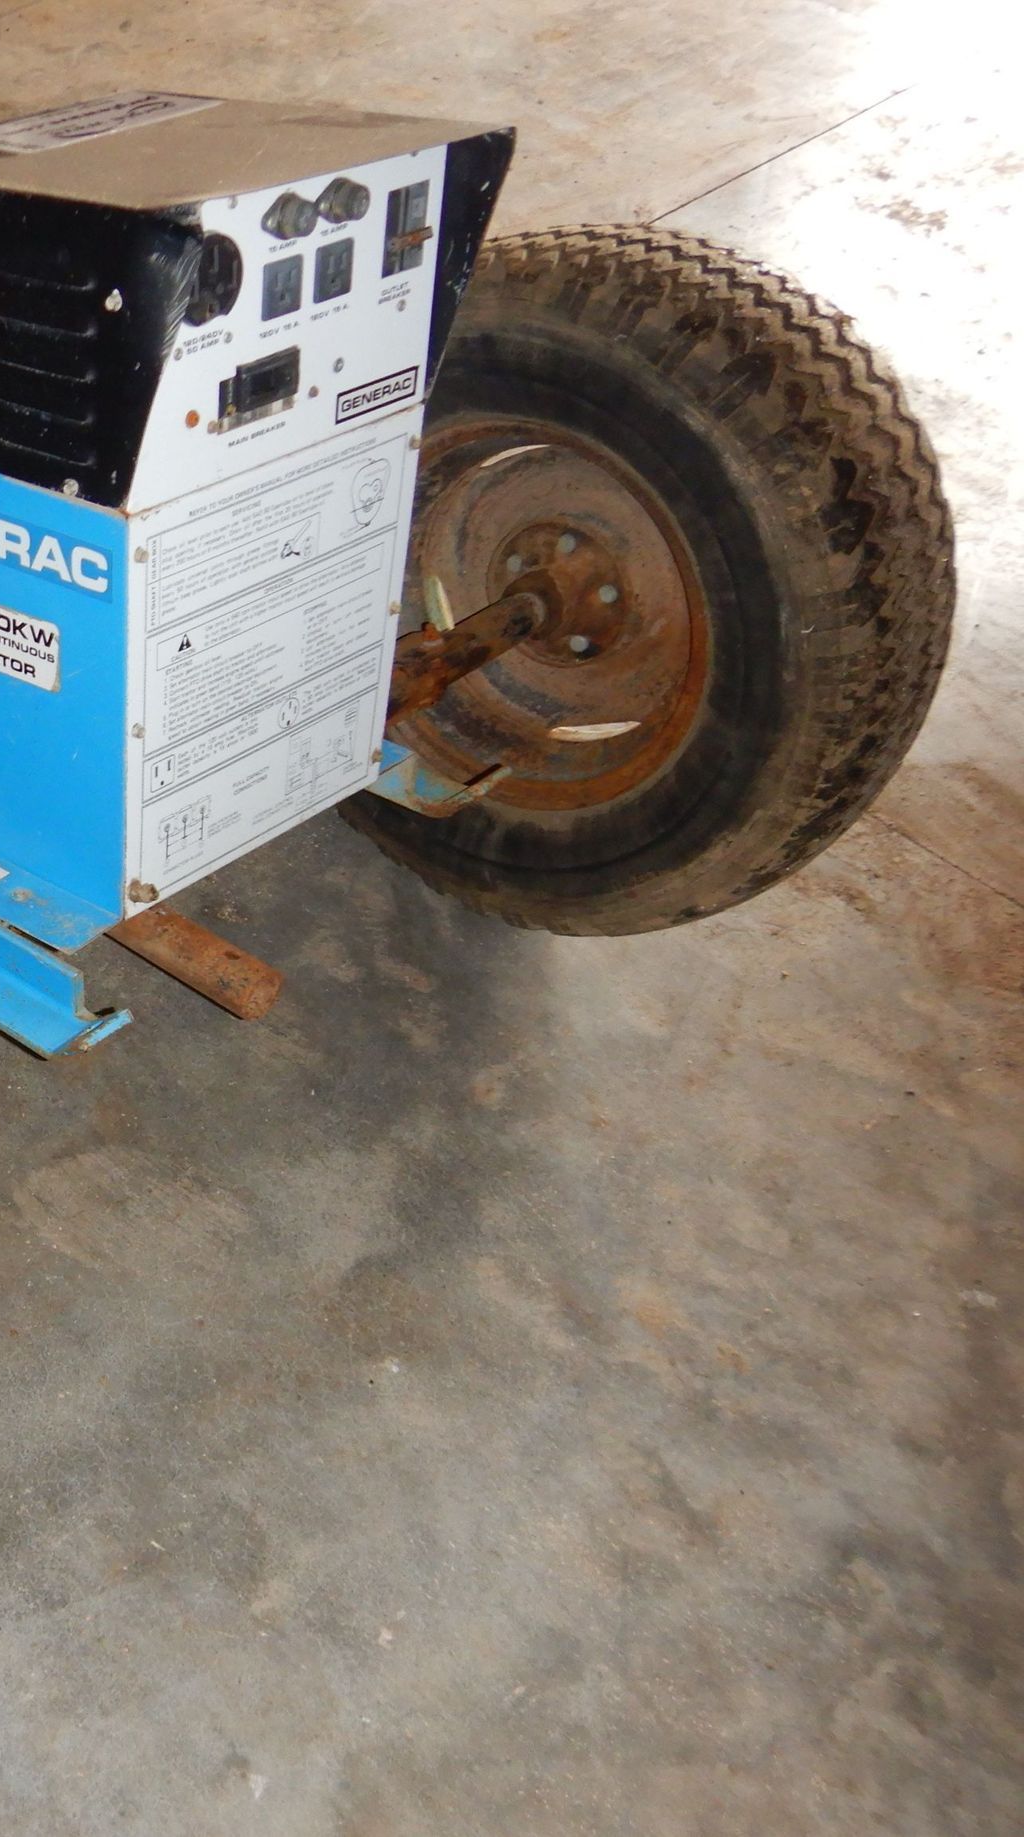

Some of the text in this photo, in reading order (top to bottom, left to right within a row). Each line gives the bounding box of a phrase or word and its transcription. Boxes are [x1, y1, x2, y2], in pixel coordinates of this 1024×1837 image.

[378, 288, 411, 305] BREAKER
[380, 281, 408, 297] OUTLET
[200, 338, 220, 352] AMP
[340, 377, 412, 413] GENERAC
[228, 420, 286, 448] MAIN BREAKER
